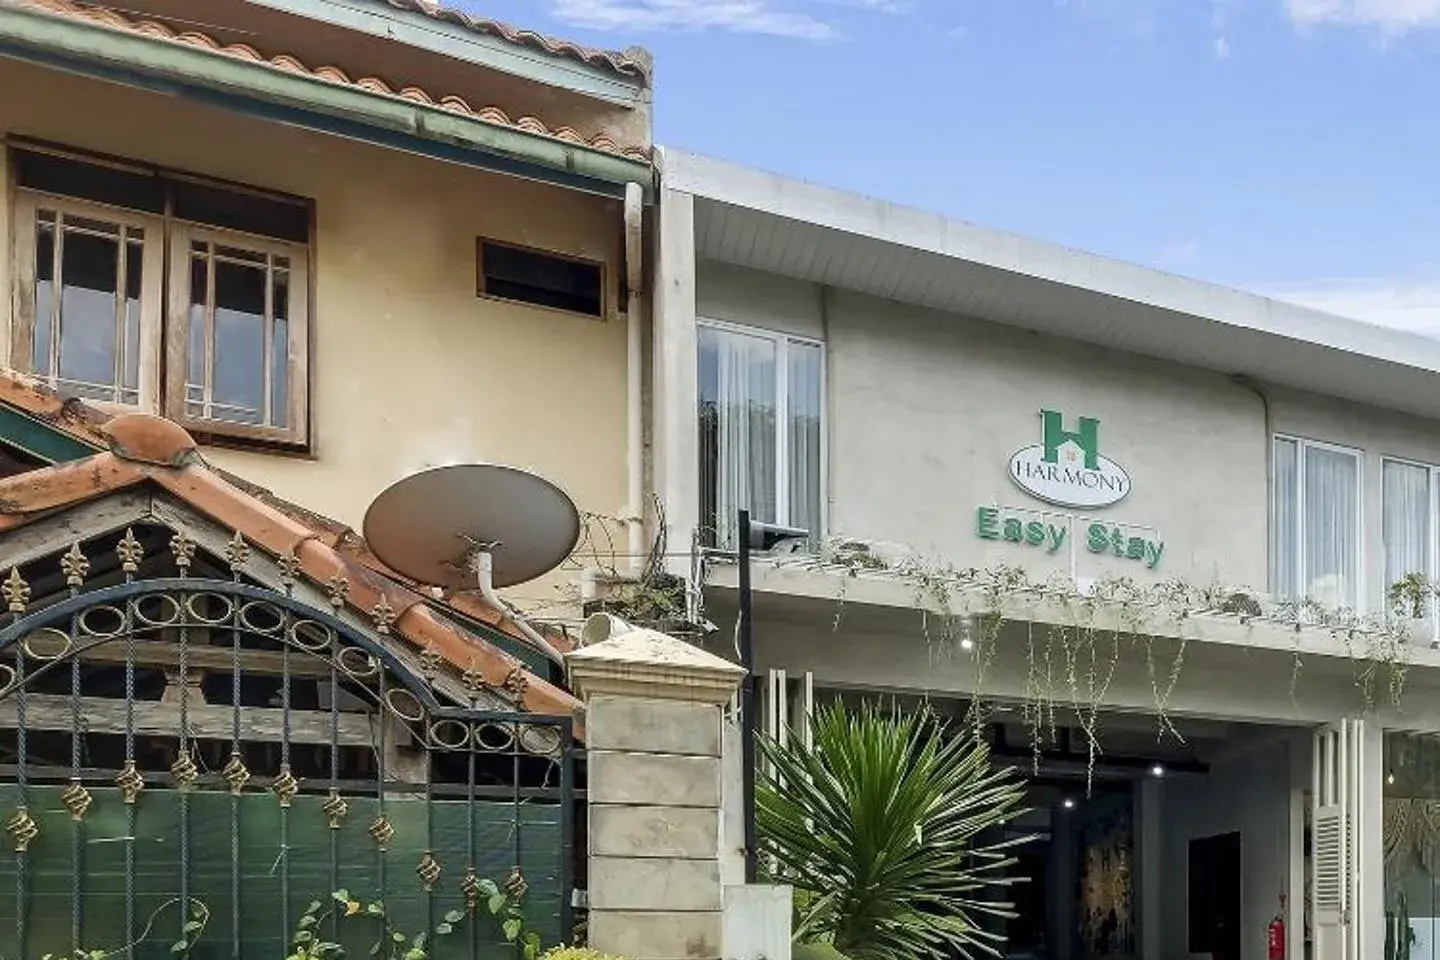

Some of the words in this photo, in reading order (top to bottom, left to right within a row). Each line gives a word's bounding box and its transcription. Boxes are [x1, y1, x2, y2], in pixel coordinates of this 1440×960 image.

[1041, 409, 1100, 470] H
[1016, 460, 1125, 492] HARMONY
[977, 506, 1067, 554] Easy
[1088, 523, 1165, 568] Stay
